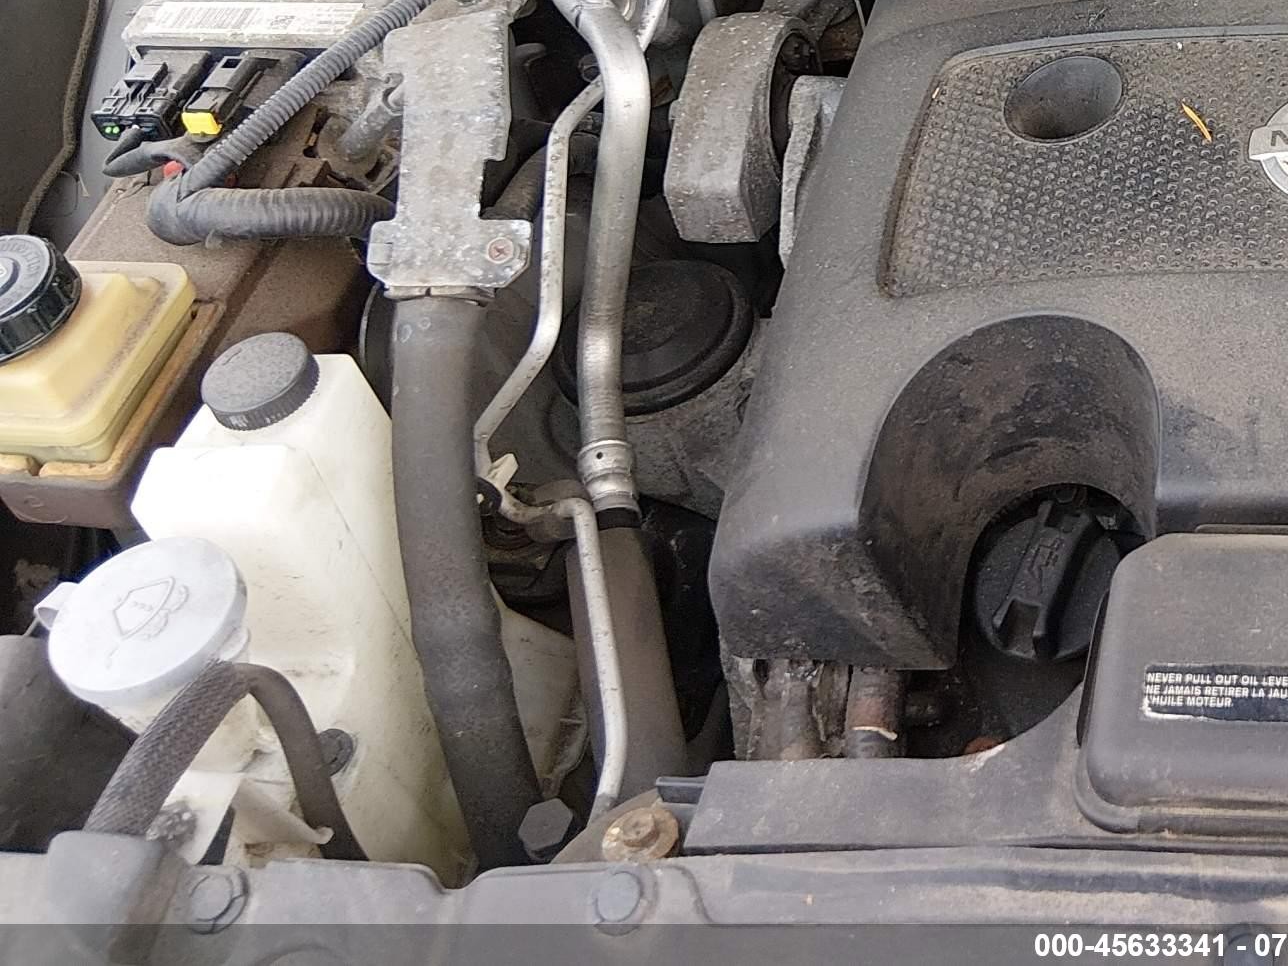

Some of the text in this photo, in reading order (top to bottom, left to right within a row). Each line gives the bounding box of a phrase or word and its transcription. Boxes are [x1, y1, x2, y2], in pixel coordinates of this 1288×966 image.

[1148, 673, 1182, 684] NEVER
[1186, 674, 1212, 684] PULL
[1215, 675, 1238, 685] OUT
[1241, 675, 1258, 686] OIL
[1146, 684, 1160, 694] NE
[1163, 685, 1201, 695] JAMAIS
[1204, 686, 1249, 697] RETIRER
[1252, 687, 1265, 698] LA
